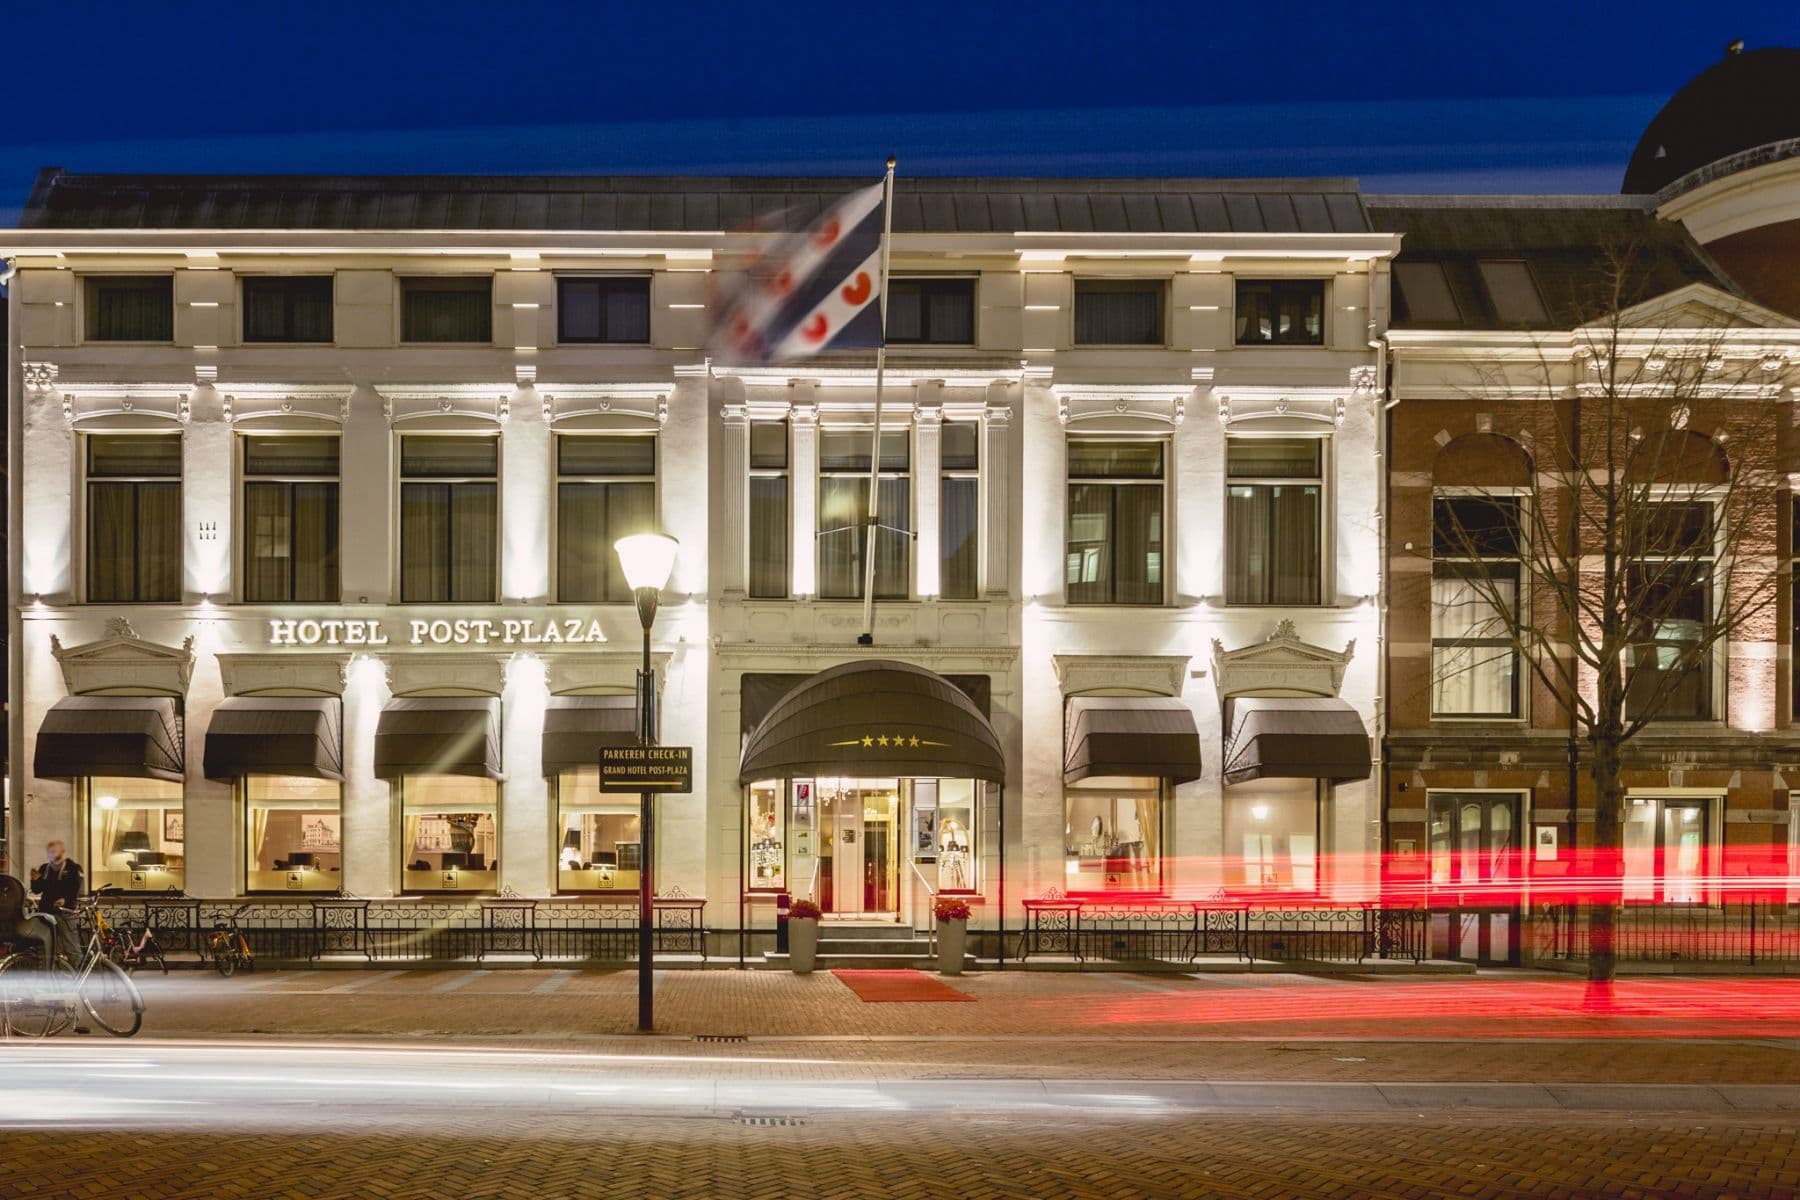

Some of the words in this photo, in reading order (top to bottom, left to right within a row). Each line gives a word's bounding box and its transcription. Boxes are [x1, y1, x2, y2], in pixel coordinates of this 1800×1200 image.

[269, 619, 388, 644] HOTEL
[409, 619, 608, 644] POST-PLAZA
[604, 750, 645, 759] PARKEREN
[648, 750, 687, 759] CHECK-IN
[604, 766, 625, 775] GRAND
[628, 766, 646, 774] HOTEL
[649, 766, 687, 775] POST-PLAZA
